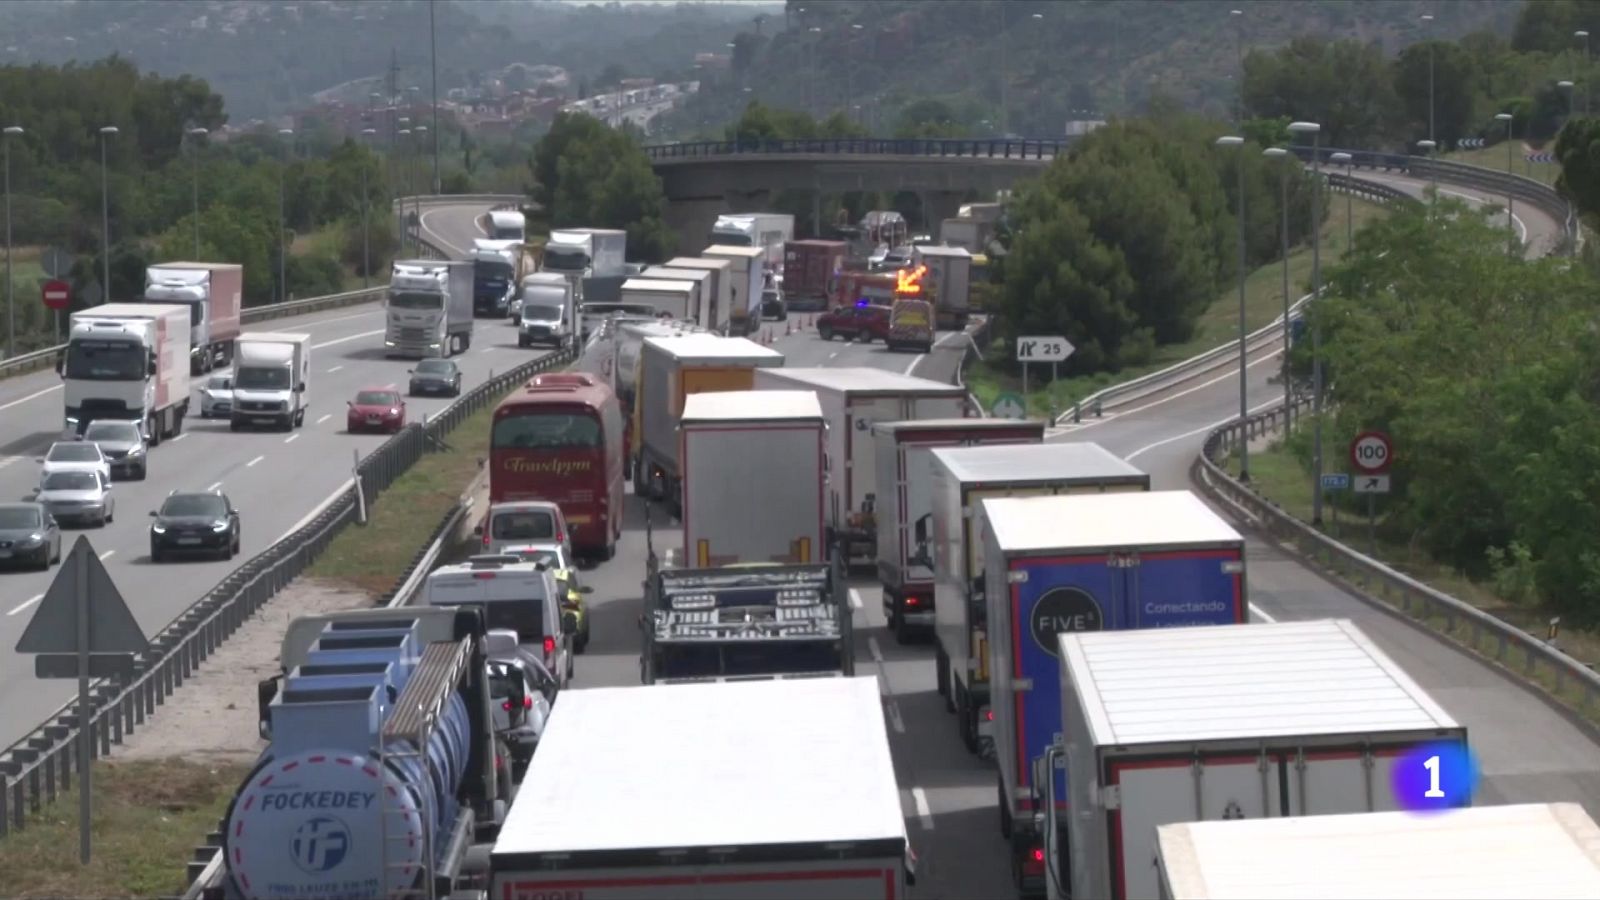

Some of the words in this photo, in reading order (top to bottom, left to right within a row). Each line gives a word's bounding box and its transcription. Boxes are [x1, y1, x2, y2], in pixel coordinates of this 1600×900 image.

[1043, 343, 1061, 354] 25
[1358, 445, 1386, 459] 100
[1145, 600, 1225, 614] Conectando
[261, 791, 376, 811] FOCKEDEY
